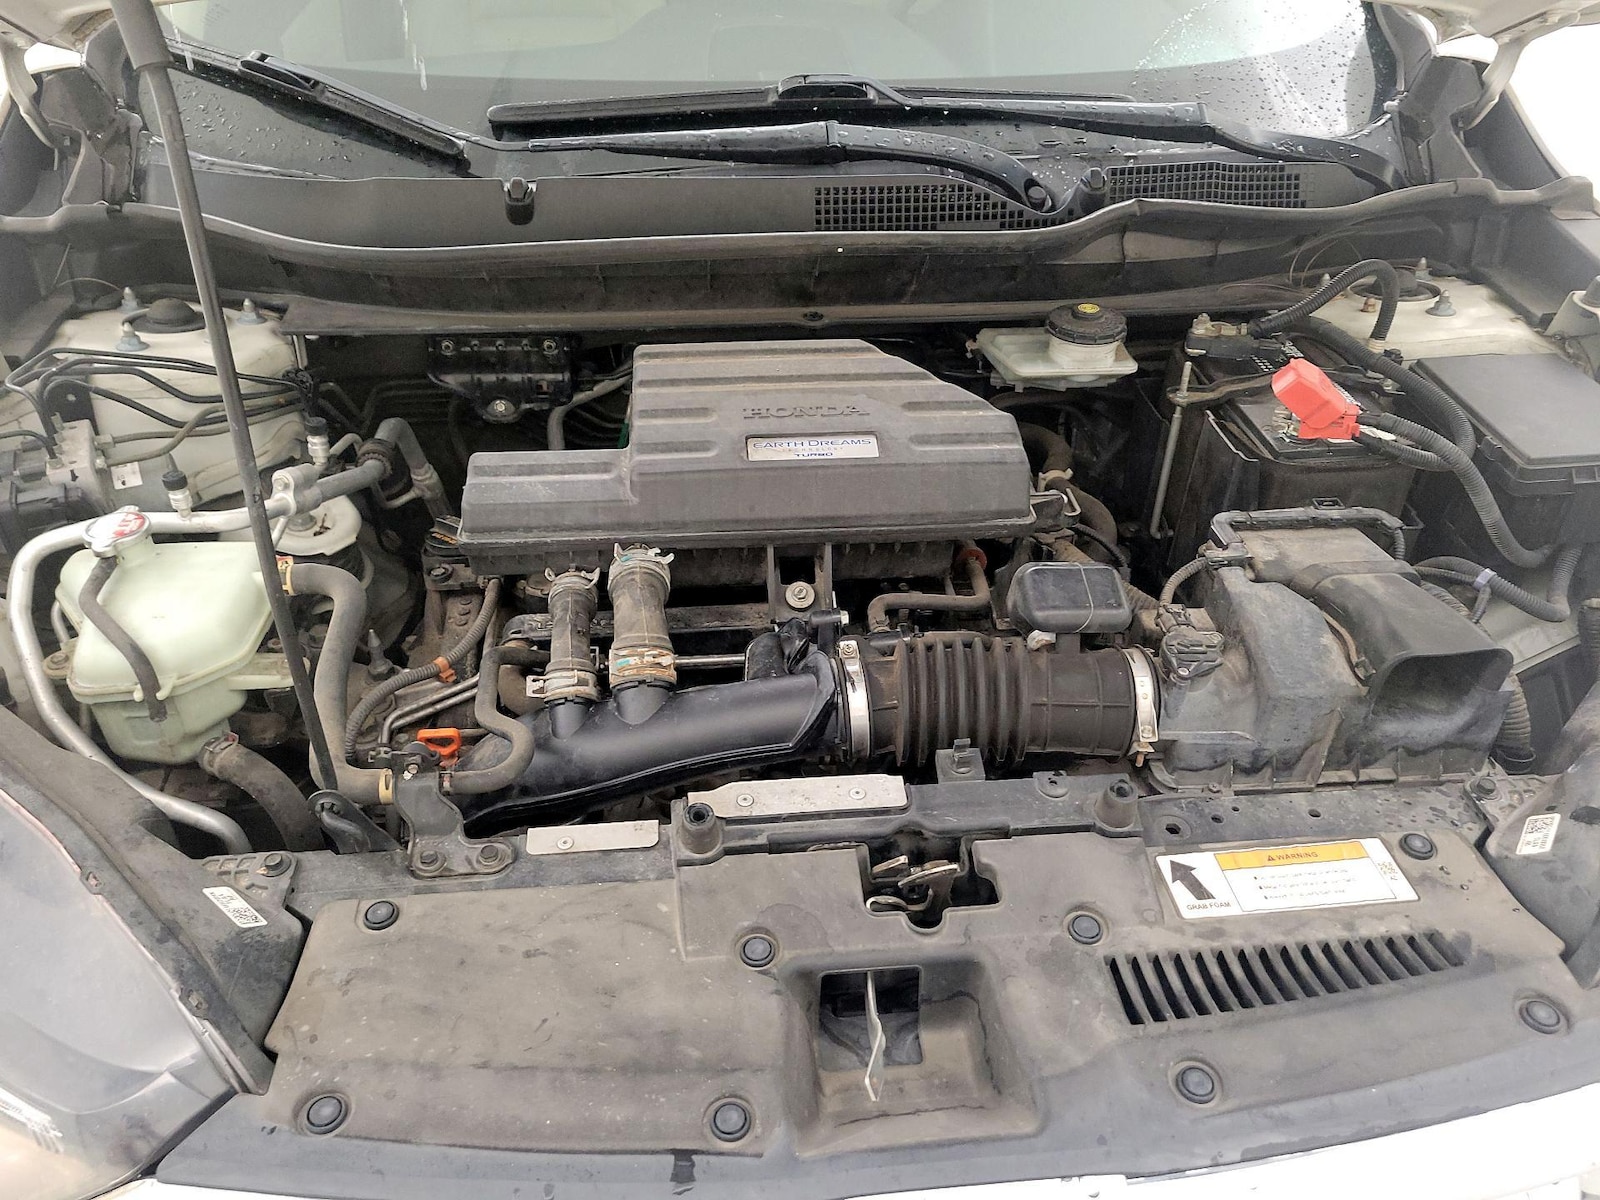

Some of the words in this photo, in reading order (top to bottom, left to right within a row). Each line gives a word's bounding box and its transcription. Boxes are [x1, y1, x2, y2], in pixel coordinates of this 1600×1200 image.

[742, 406, 870, 419] HONDA
[753, 441, 804, 449] EARTH
[808, 438, 872, 447] DREAMS
[1276, 851, 1319, 861] WARNING
[1210, 901, 1232, 909] FOAM
